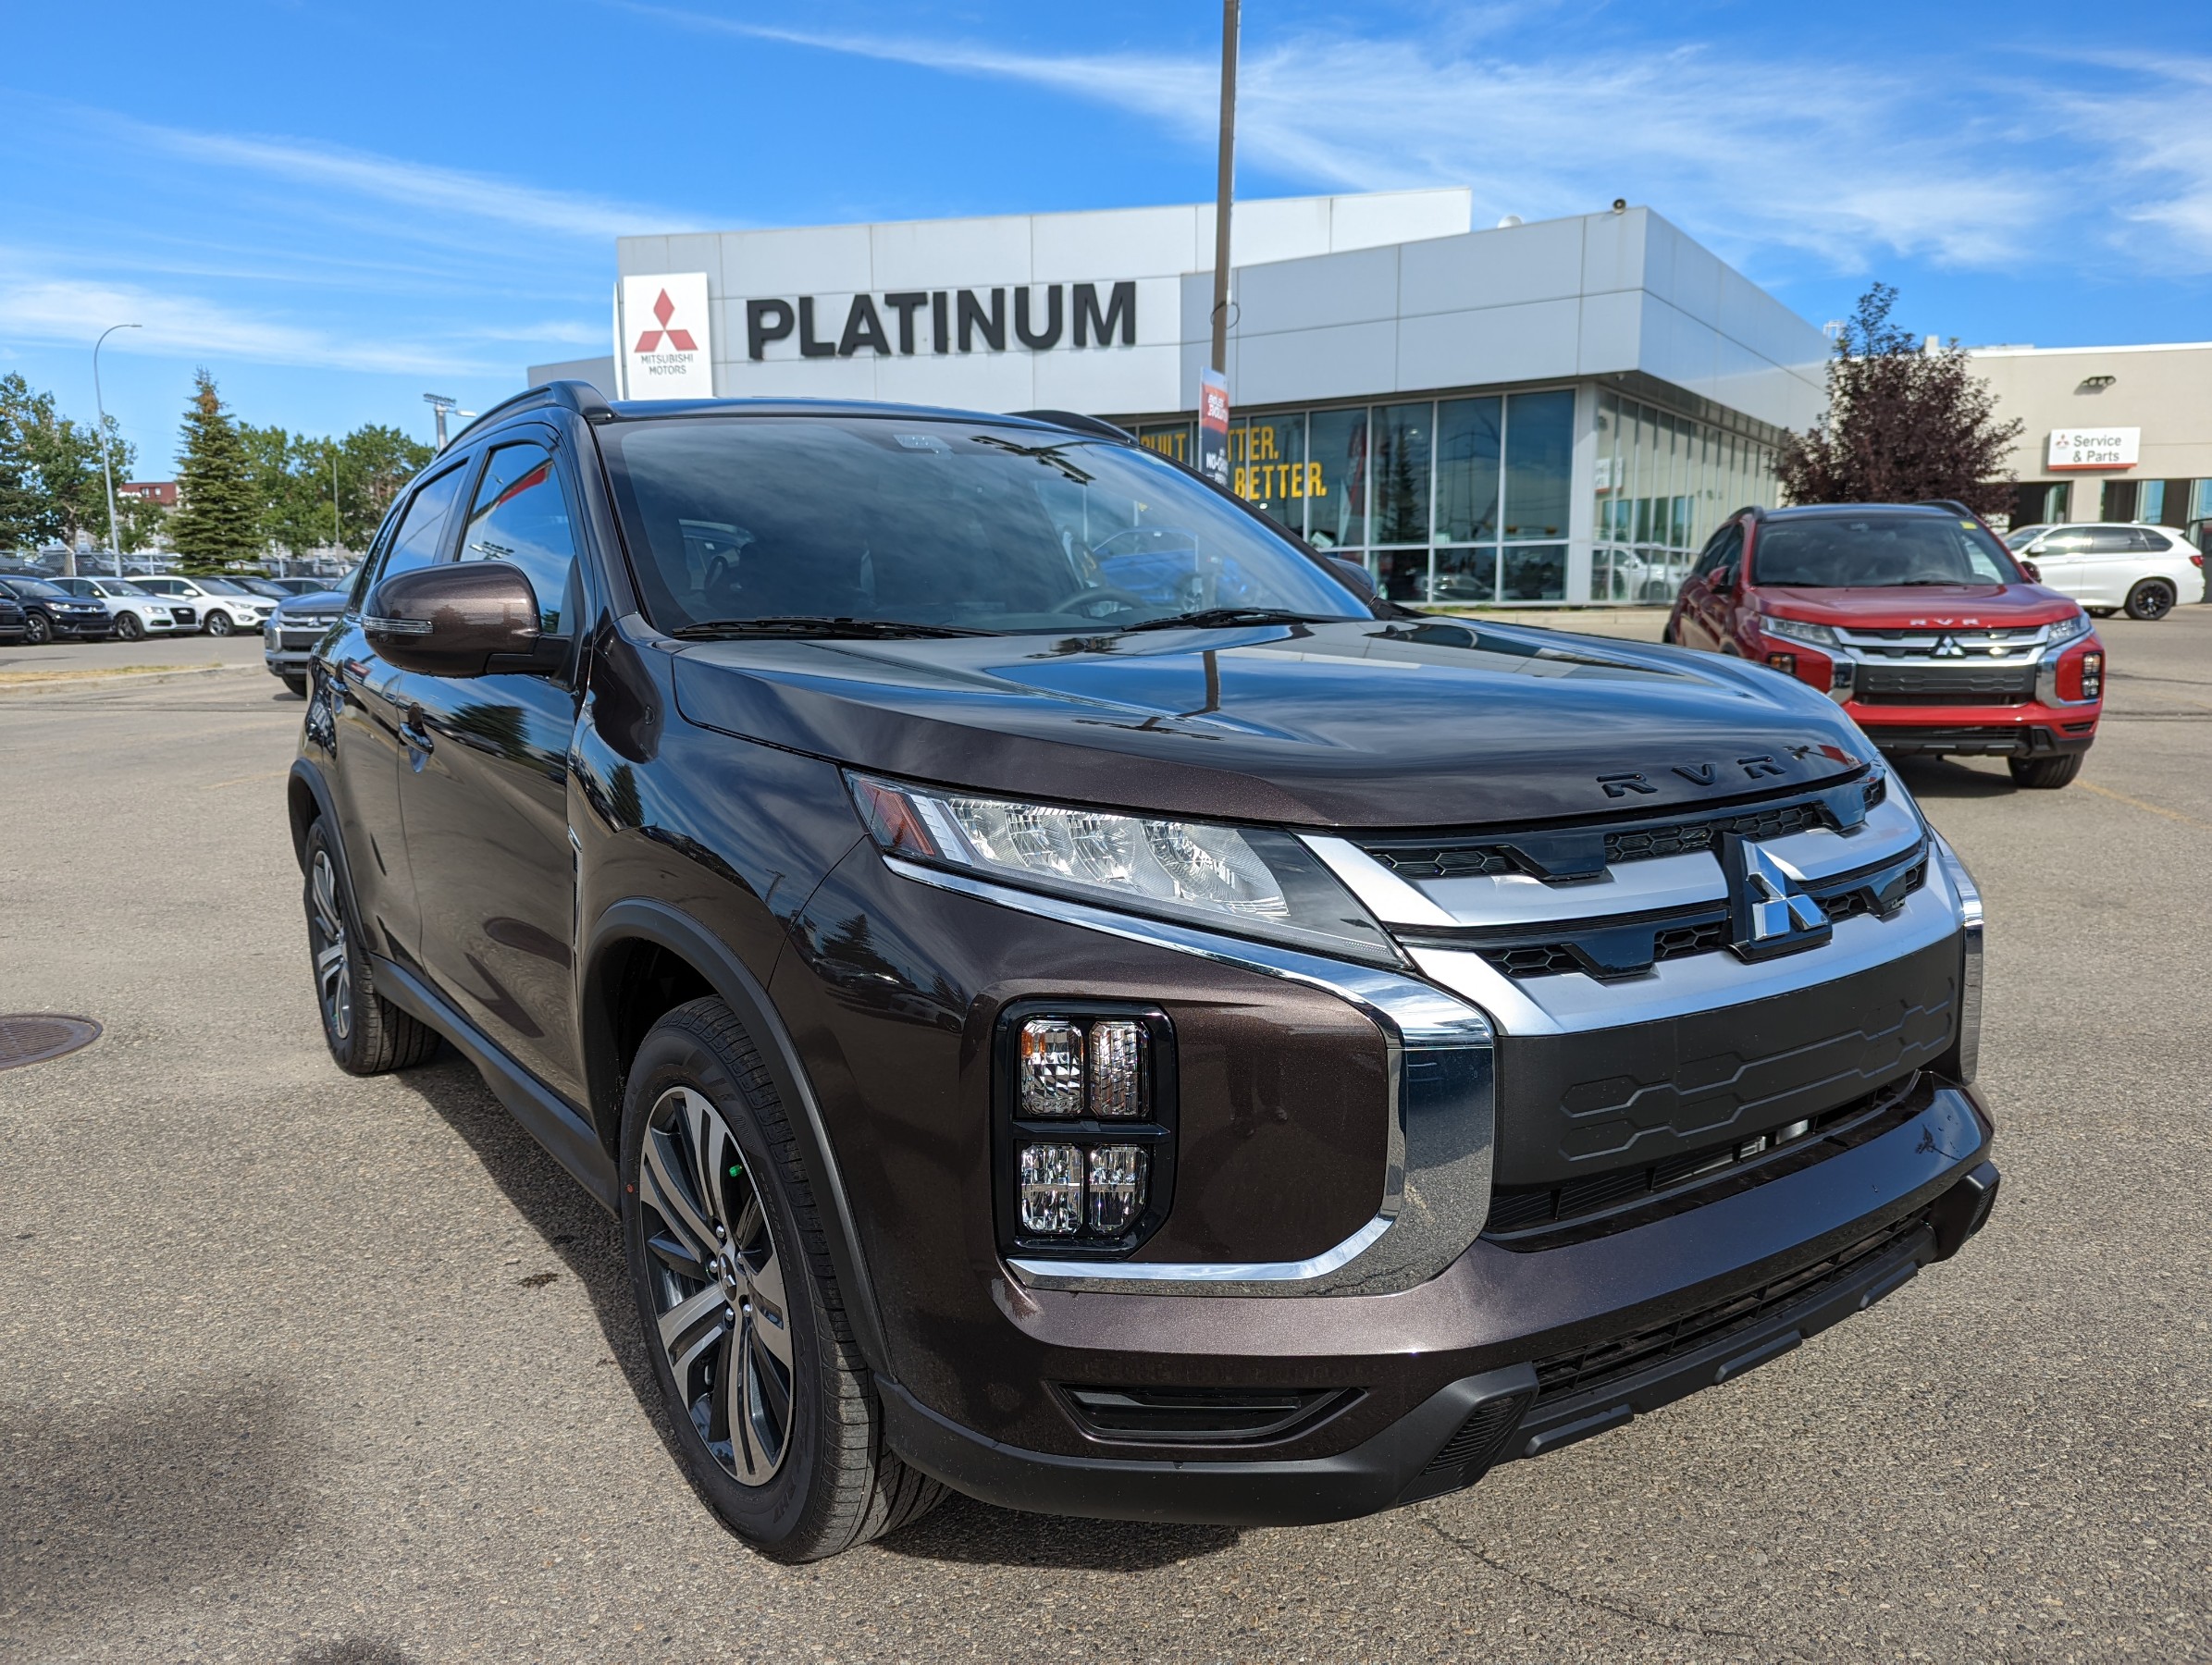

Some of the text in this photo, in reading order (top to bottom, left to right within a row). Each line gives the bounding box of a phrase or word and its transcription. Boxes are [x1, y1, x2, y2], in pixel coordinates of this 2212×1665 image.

[746, 281, 1135, 360] PLATINUM
[641, 353, 694, 364] MITSUBISHI
[649, 364, 687, 376] MOTORS
[2073, 435, 2122, 448] Service
[2073, 450, 2120, 462] & Parts
[1234, 462, 1328, 500] BETTER.
[1909, 618, 1980, 626] RVR
[1596, 754, 1787, 798] RVR
